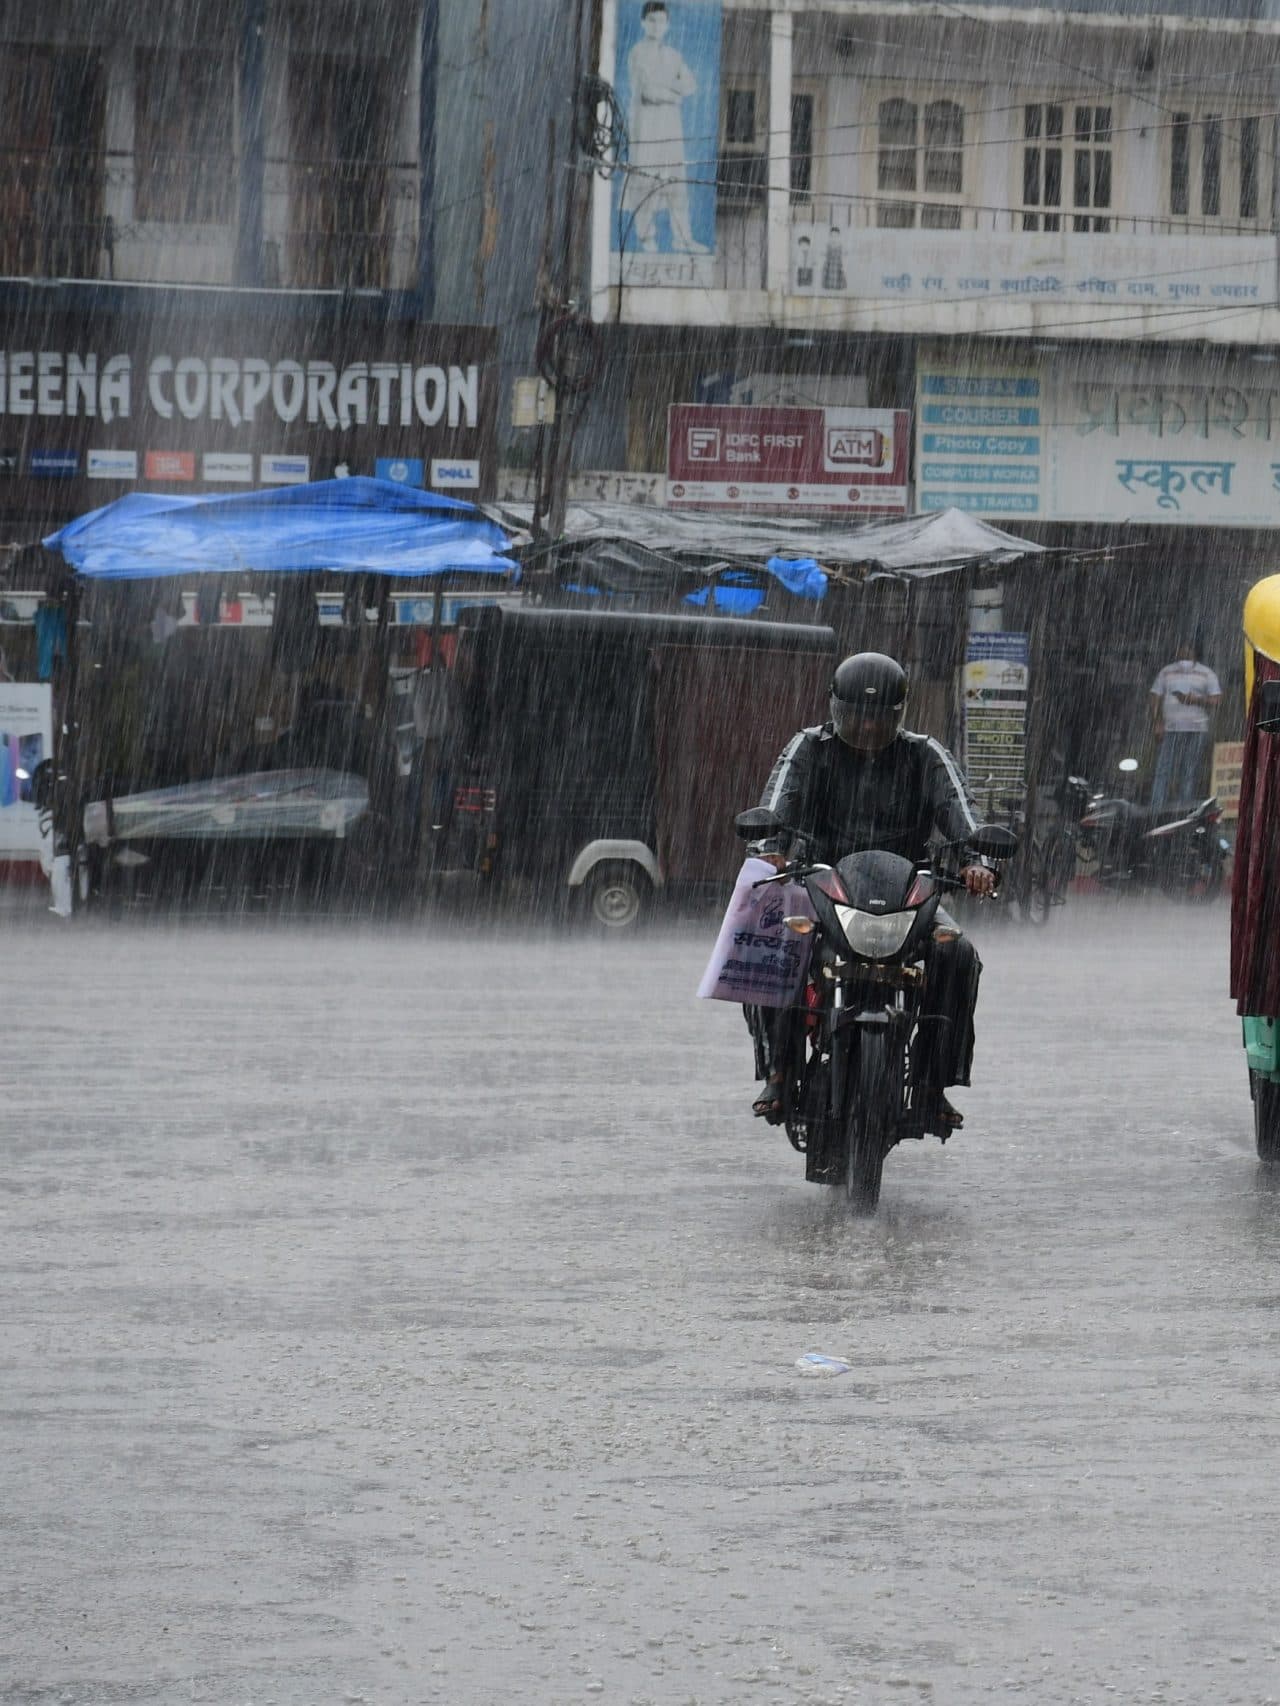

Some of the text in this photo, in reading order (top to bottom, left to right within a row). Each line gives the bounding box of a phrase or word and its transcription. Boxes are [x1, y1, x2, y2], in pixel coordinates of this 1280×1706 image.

[0, 350, 478, 431] EENA CORPORATION
[942, 407, 1020, 424] COURIER
[726, 434, 804, 448] IDFC FIRST
[832, 439, 873, 455] ATM
[934, 436, 1028, 454] Photo Copy
[726, 449, 761, 463] Bank
[1115, 459, 1236, 511] स्कूल
